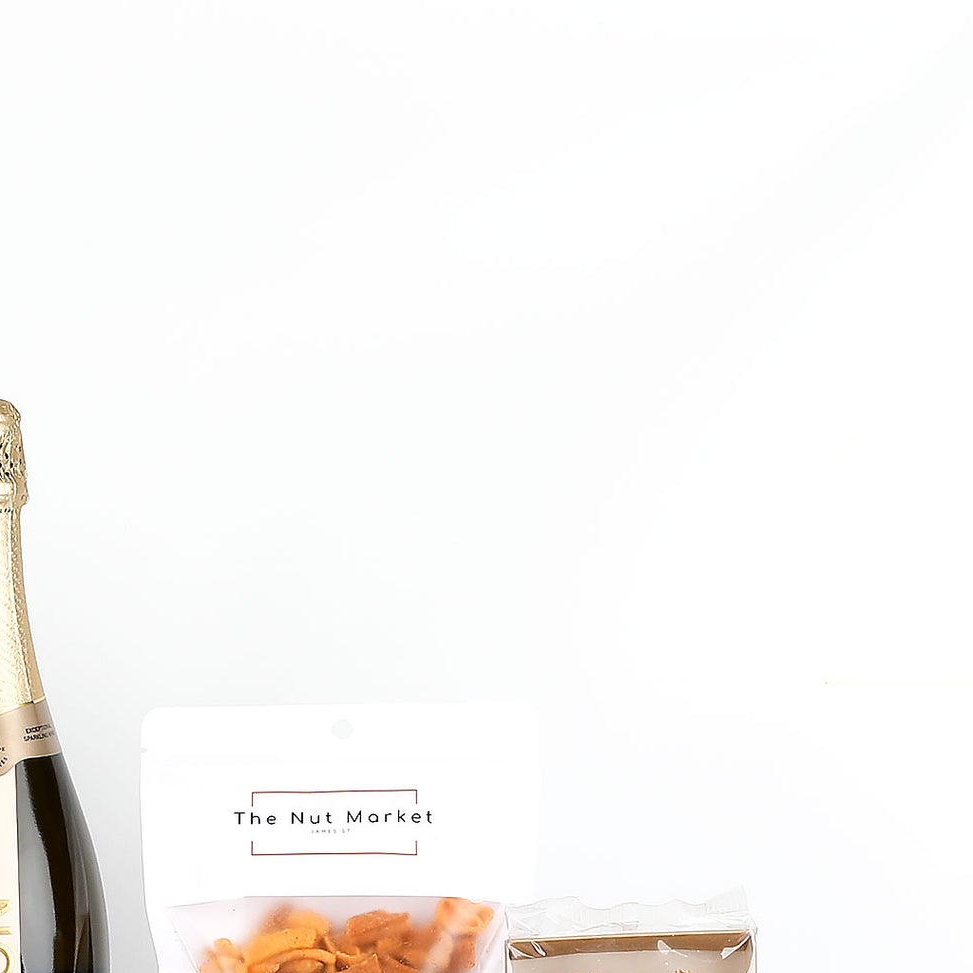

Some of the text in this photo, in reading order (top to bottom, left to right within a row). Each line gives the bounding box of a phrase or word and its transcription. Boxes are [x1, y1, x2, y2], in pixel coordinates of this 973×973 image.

[234, 809, 433, 825] The Nut Market
